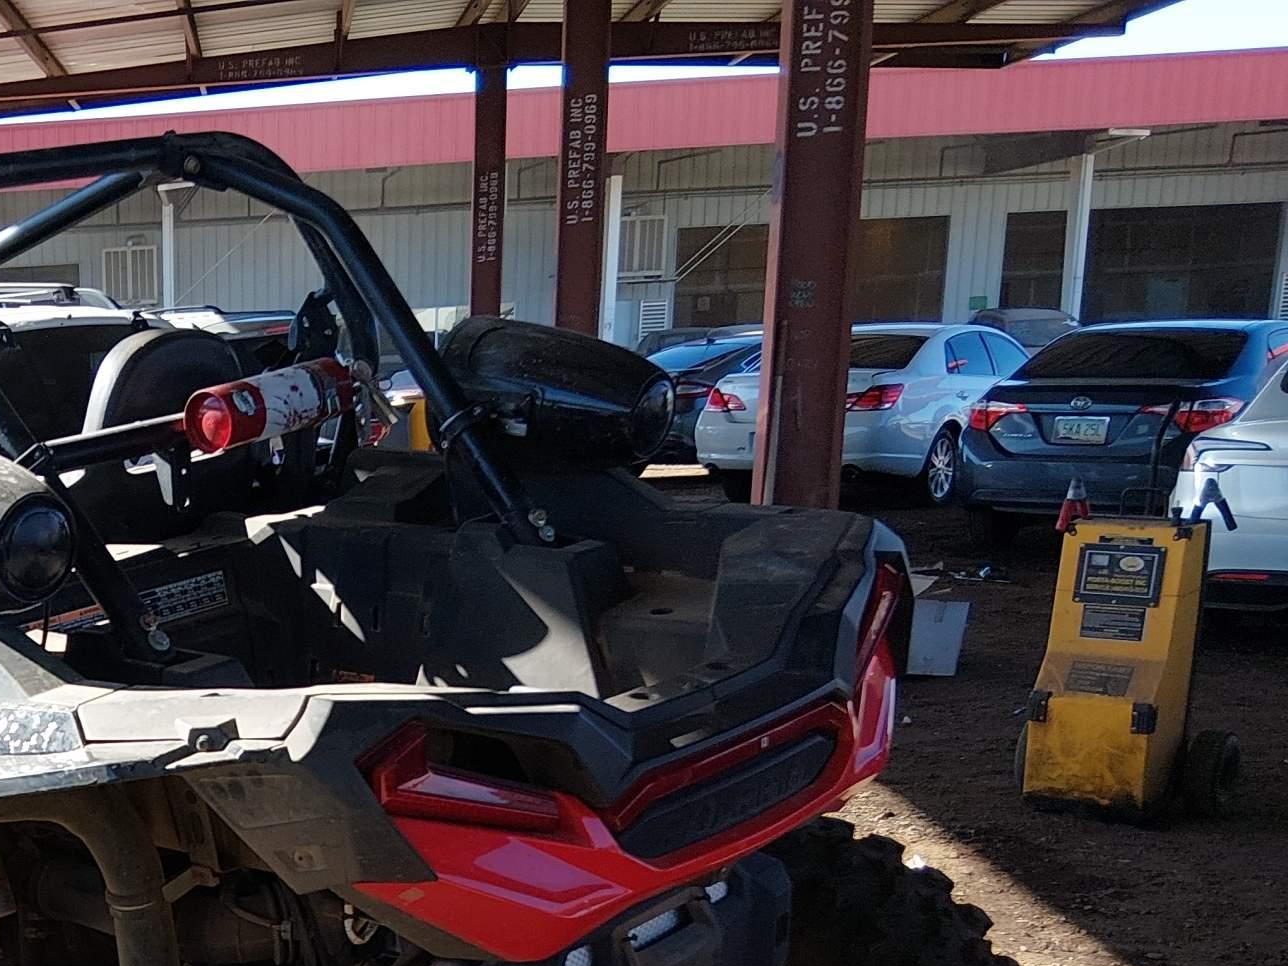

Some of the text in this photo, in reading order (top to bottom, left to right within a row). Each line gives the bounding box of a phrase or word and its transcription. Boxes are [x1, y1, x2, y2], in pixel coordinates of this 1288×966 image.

[796, 87, 821, 137] U.S.
[567, 129, 582, 188] PREFAB
[580, 94, 598, 222] 1-866-799-0969
[566, 195, 580, 225] U.S.
